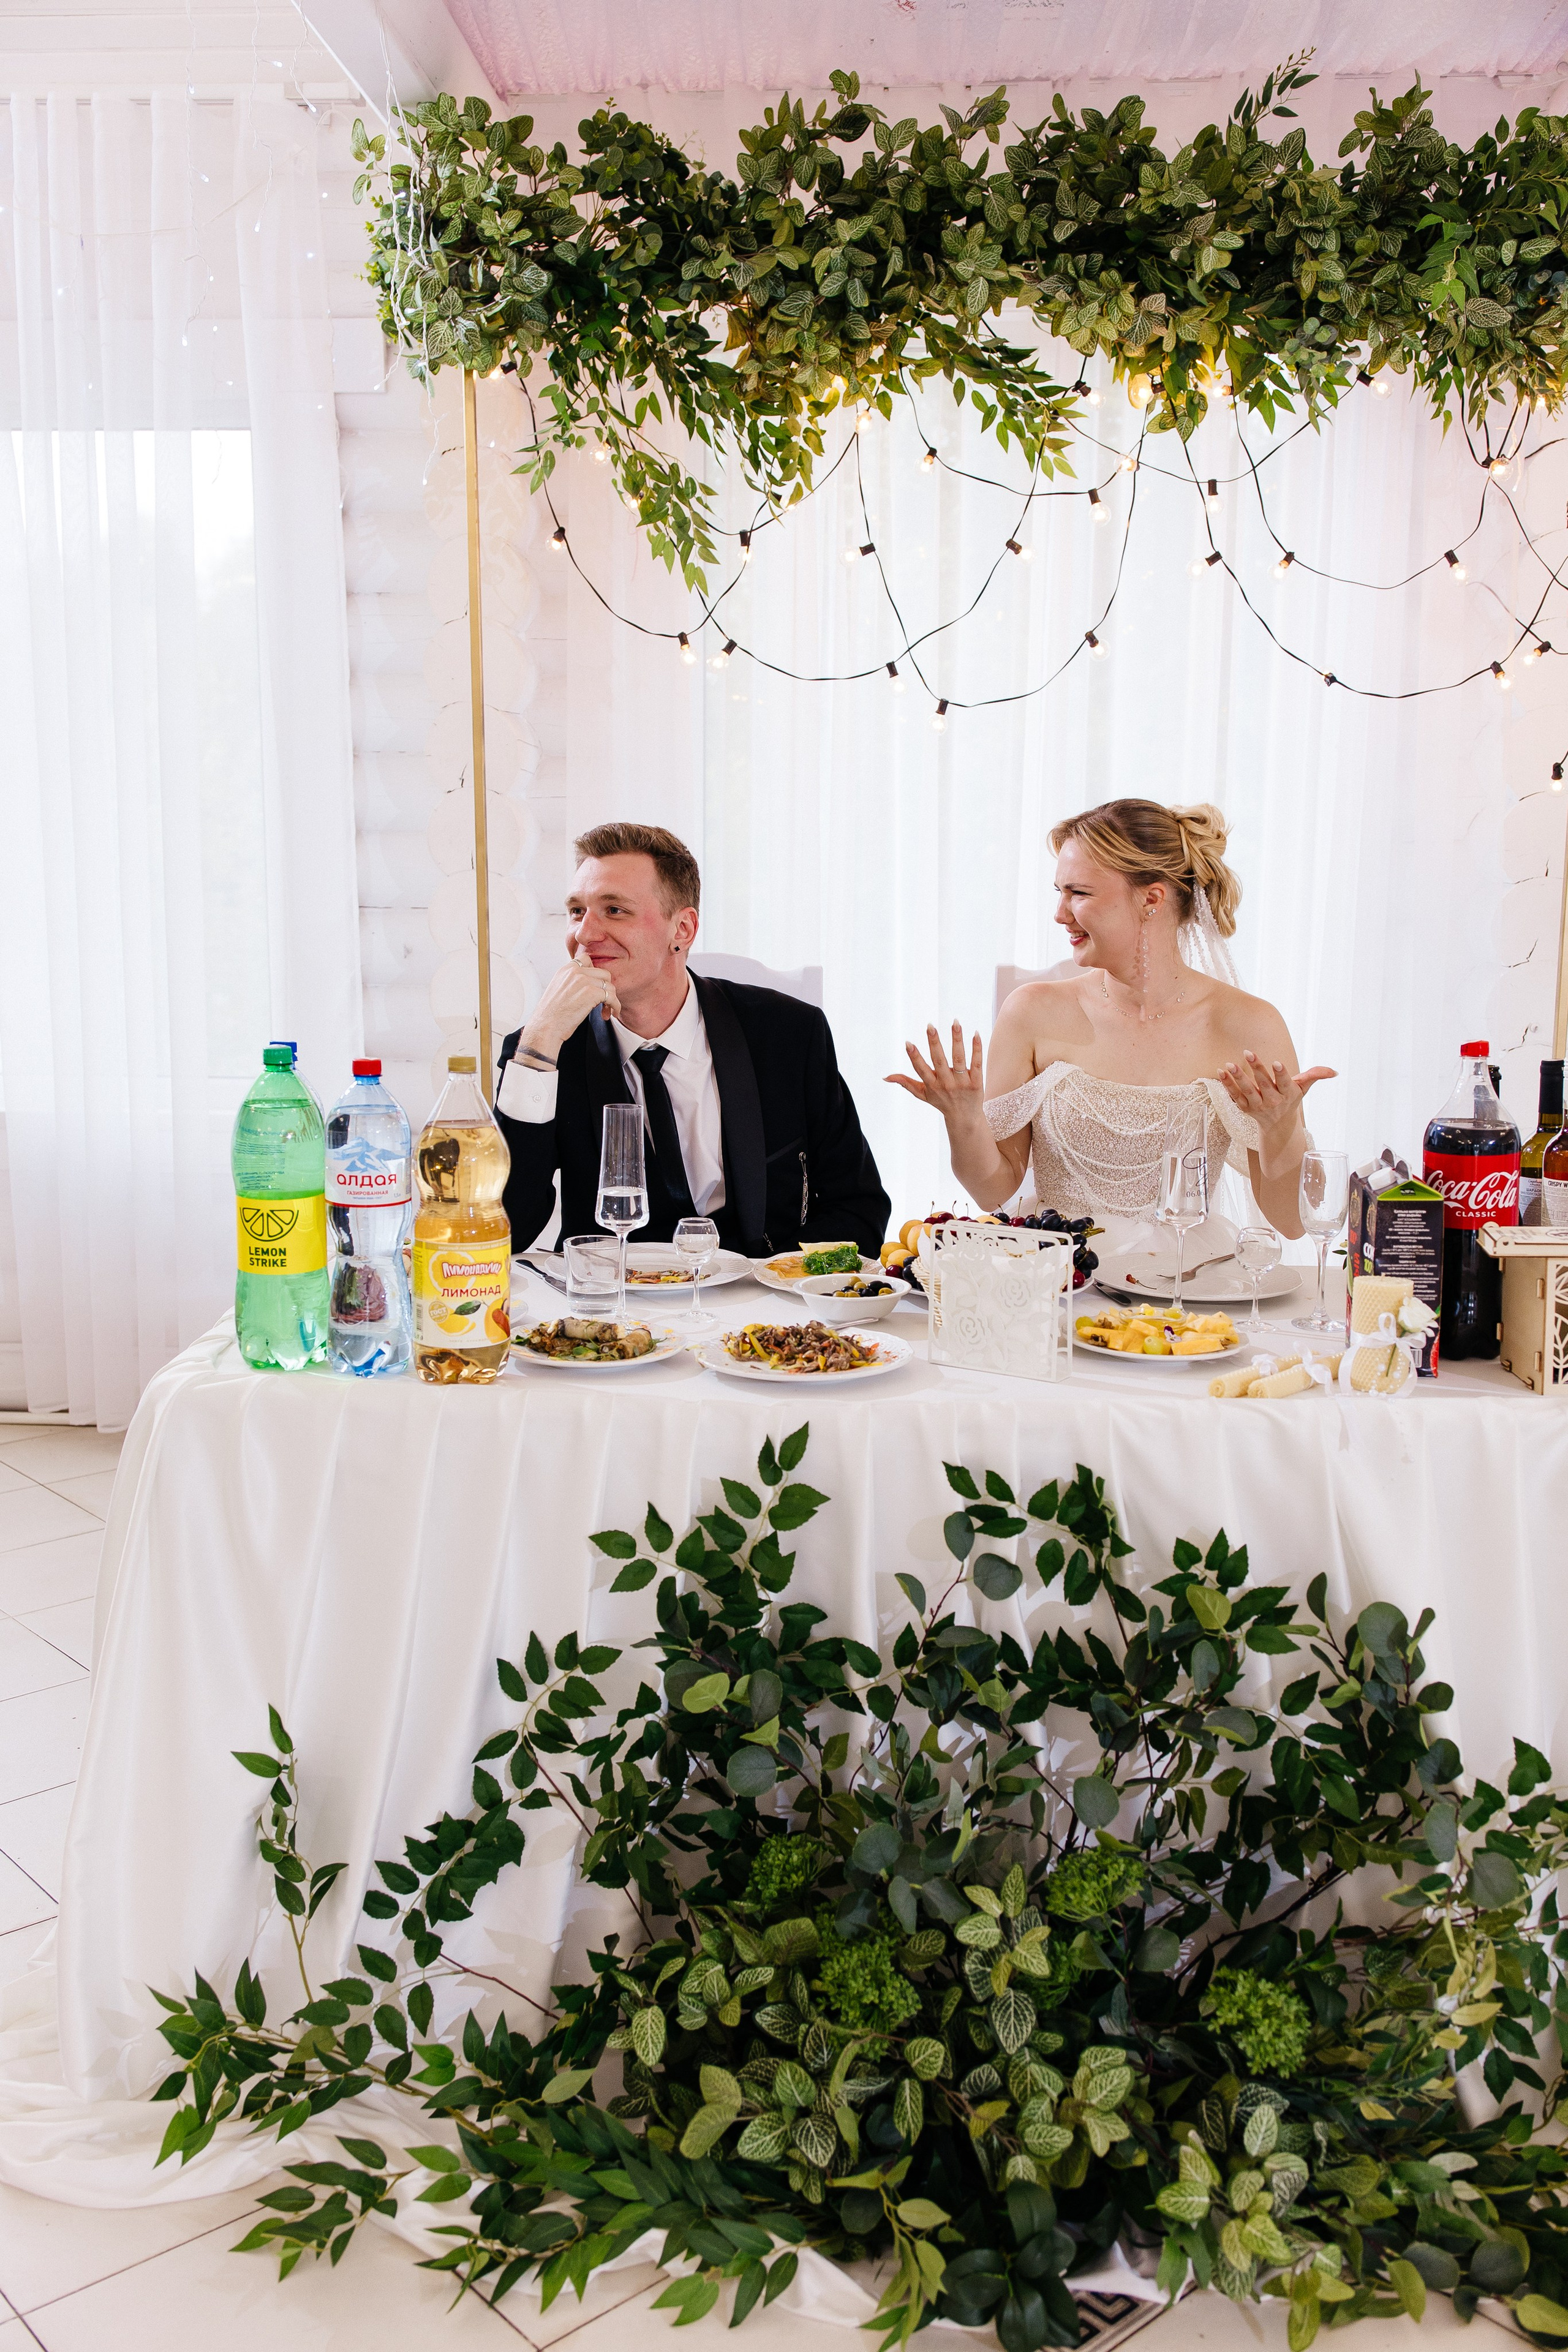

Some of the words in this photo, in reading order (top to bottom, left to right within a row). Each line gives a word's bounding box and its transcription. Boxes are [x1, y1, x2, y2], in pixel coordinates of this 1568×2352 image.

[1426, 1170, 1519, 1210] Coca-Cola
[249, 1246, 287, 1256] LEMON
[249, 1257, 287, 1267] STRIKE
[441, 1284, 501, 1297] ЛИМОНАД
